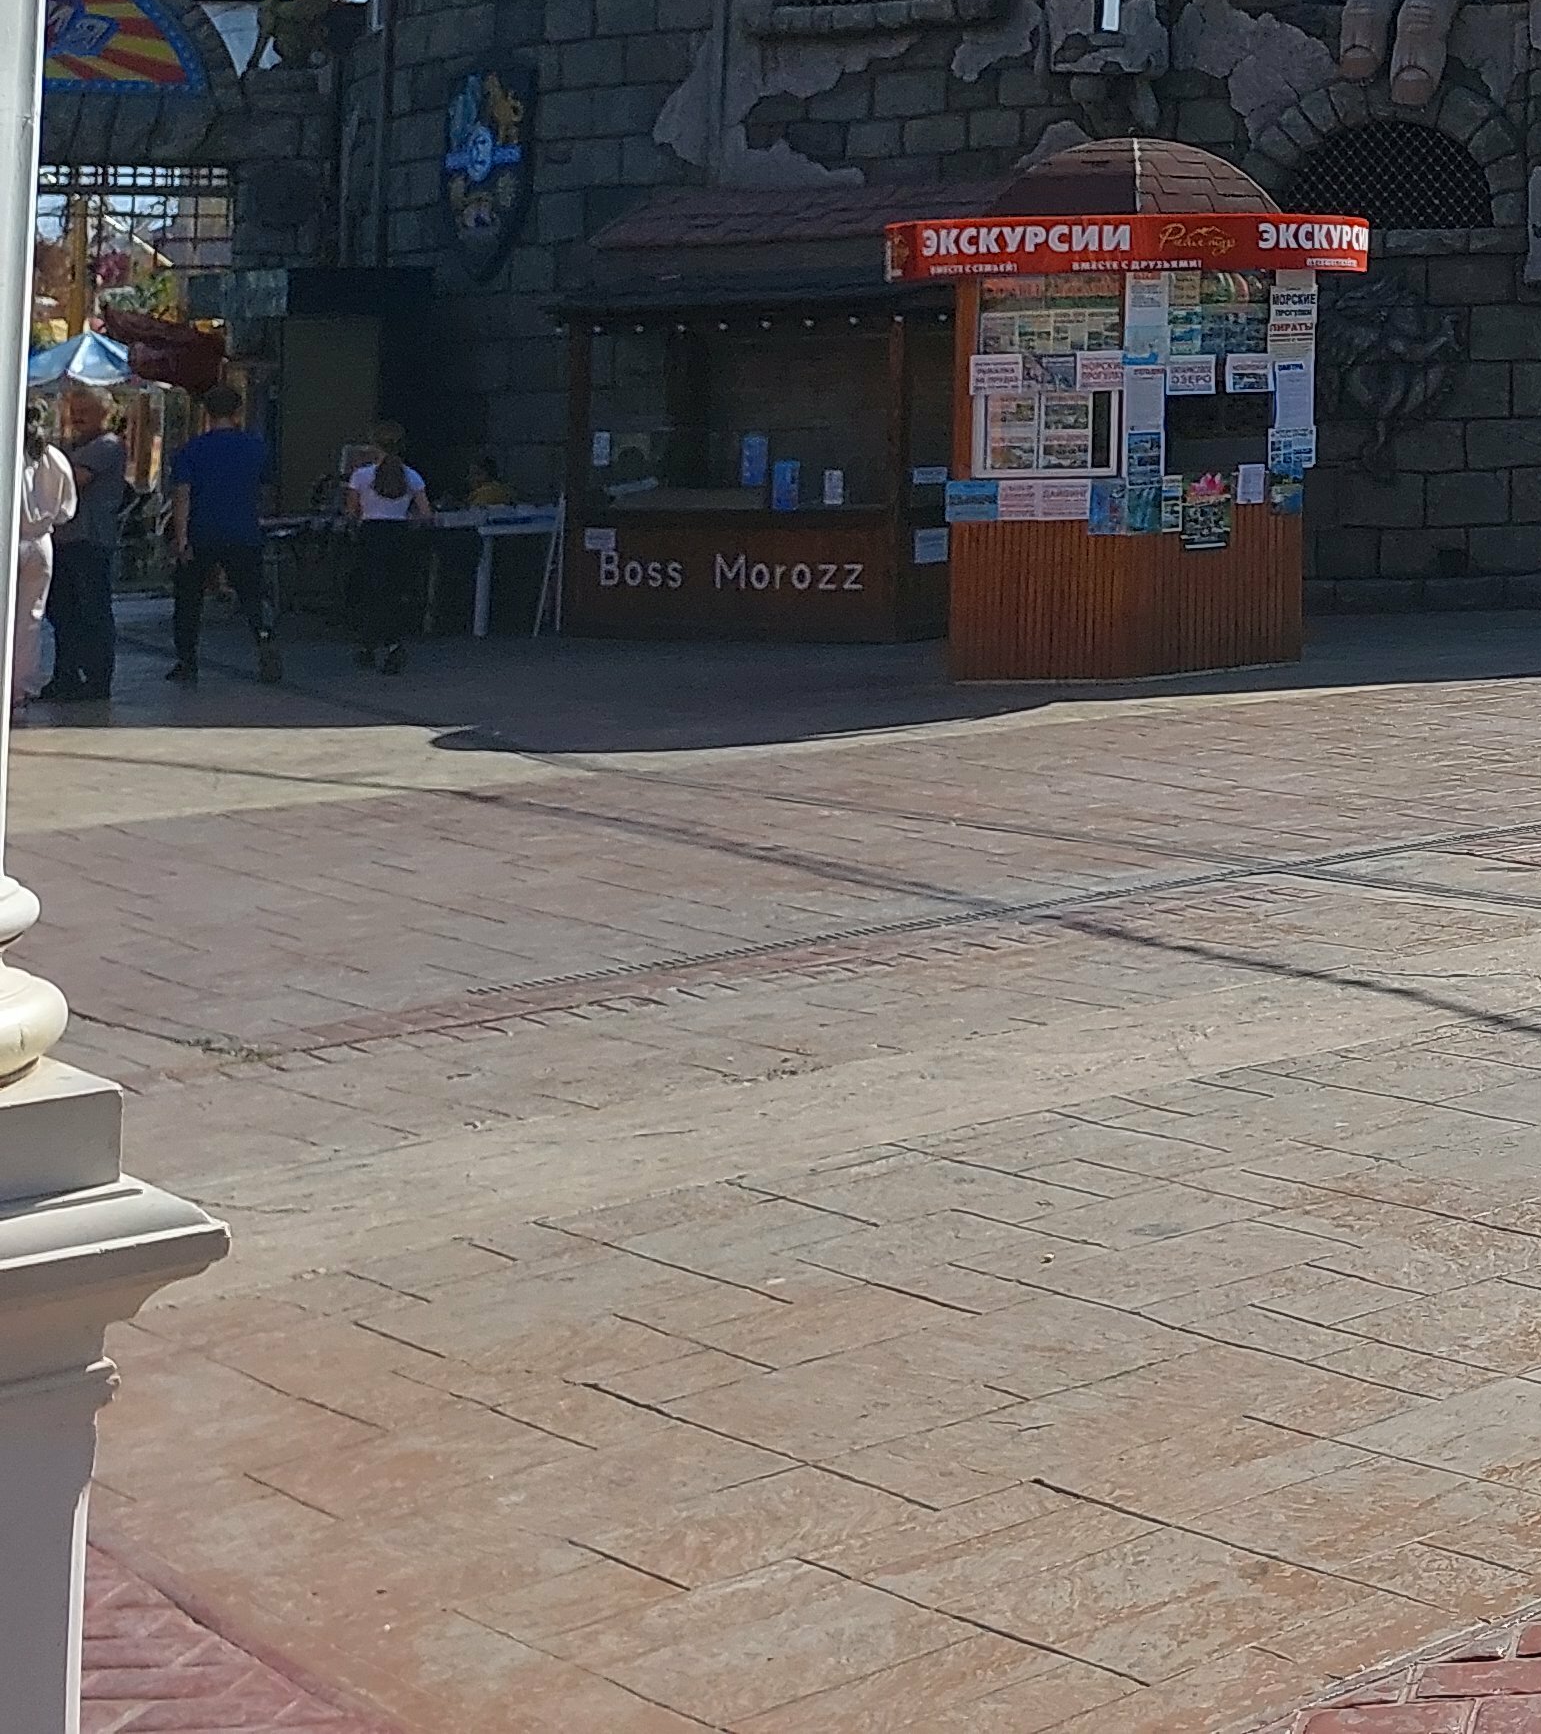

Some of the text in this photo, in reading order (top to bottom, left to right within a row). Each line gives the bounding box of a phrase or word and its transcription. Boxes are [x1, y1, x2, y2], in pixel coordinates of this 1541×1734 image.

[922, 223, 1131, 257] ЭКСКУРСИИ
[1072, 260, 1119, 271] ВМЕСТЕ
[1121, 260, 1129, 270] С
[1272, 293, 1316, 305] МОРСКИЕ
[600, 551, 864, 591] Boss Morozz
